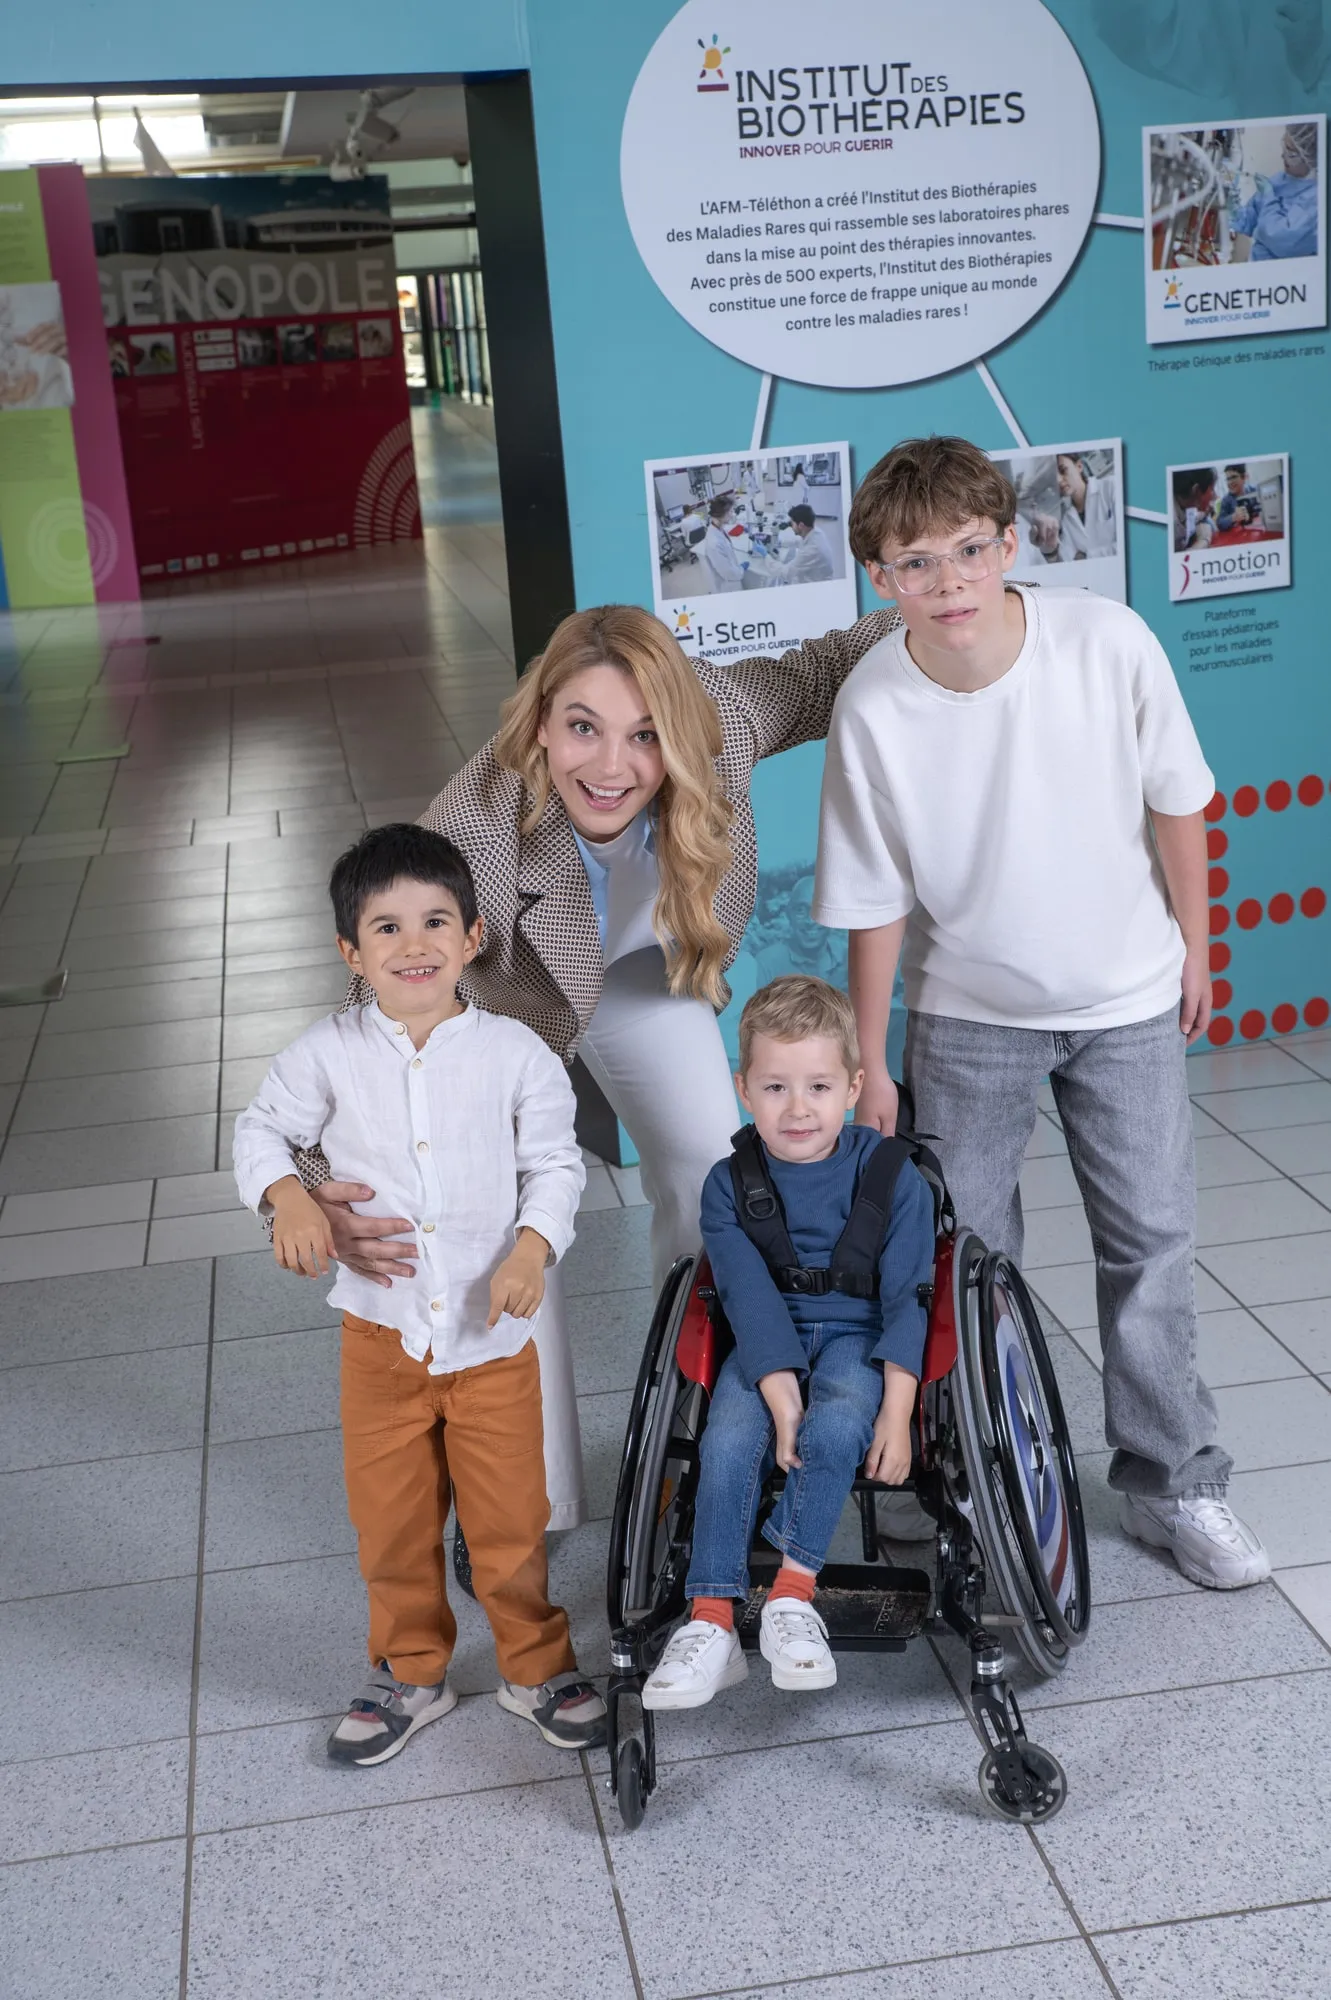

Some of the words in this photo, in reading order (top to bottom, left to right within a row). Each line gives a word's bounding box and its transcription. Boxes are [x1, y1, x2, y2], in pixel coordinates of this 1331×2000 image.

[735, 62, 911, 103] INSTITUT
[911, 75, 949, 93] DES
[738, 91, 1026, 140] BIOTHÉRAPIES
[739, 144, 801, 159] INNOVER
[804, 141, 842, 155] POUR
[700, 196, 811, 216] L'AFM-Téléthon
[814, 197, 824, 209] a
[826, 191, 858, 208] créé
[861, 188, 920, 205] l'Institut
[923, 186, 948, 201] des
[951, 180, 1037, 199] Biothérapies
[666, 228, 692, 243] des
[696, 223, 762, 241] Maladies
[765, 221, 806, 236] Rares
[809, 218, 831, 236] qui
[834, 212, 908, 231] rassemble
[912, 212, 936, 226] ses
[939, 205, 1021, 224] laboratoires
[1024, 201, 1070, 221] phares
[706, 250, 741, 265] dans
[745, 248, 758, 262] la
[761, 246, 795, 261] mise
[799, 245, 816, 258] au
[820, 241, 856, 260] point
[860, 239, 885, 254] des
[889, 234, 955, 252] thérapies
[958, 229, 1036, 247] innovantes.
[690, 276, 726, 290] Avec
[730, 272, 761, 291] près
[764, 270, 782, 285] de
[786, 268, 816, 283] 500
[819, 264, 876, 283] experts,
[879, 260, 937, 276] l'Institut
[940, 257, 965, 271] des
[968, 250, 1053, 269] Biothérapies
[709, 296, 776, 313] constitue
[780, 295, 806, 307] une
[810, 291, 847, 305] force
[850, 287, 868, 302] de
[871, 285, 917, 302] frappe
[921, 281, 968, 298] unique
[971, 279, 988, 291] au
[991, 274, 1038, 290] monde
[786, 316, 832, 331] contre
[835, 313, 855, 327] les
[859, 308, 922, 326] maladies
[925, 305, 961, 319] rares
[963, 303, 969, 316] !
[1148, 358, 1190, 372] Thérapie
[1193, 353, 1232, 368] Génique
[1234, 350, 1252, 363] des
[1254, 347, 1297, 361] maladies
[1300, 344, 1326, 356] rares
[1204, 607, 1257, 622] Plateforme
[697, 621, 776, 647] I-Stem
[1189, 645, 1212, 659] pour
[1214, 642, 1228, 653] les
[1231, 636, 1272, 651] maladies
[699, 646, 740, 658] INNOVER
[741, 642, 766, 653] POUR
[1190, 653, 1274, 673] neuromusculaires
